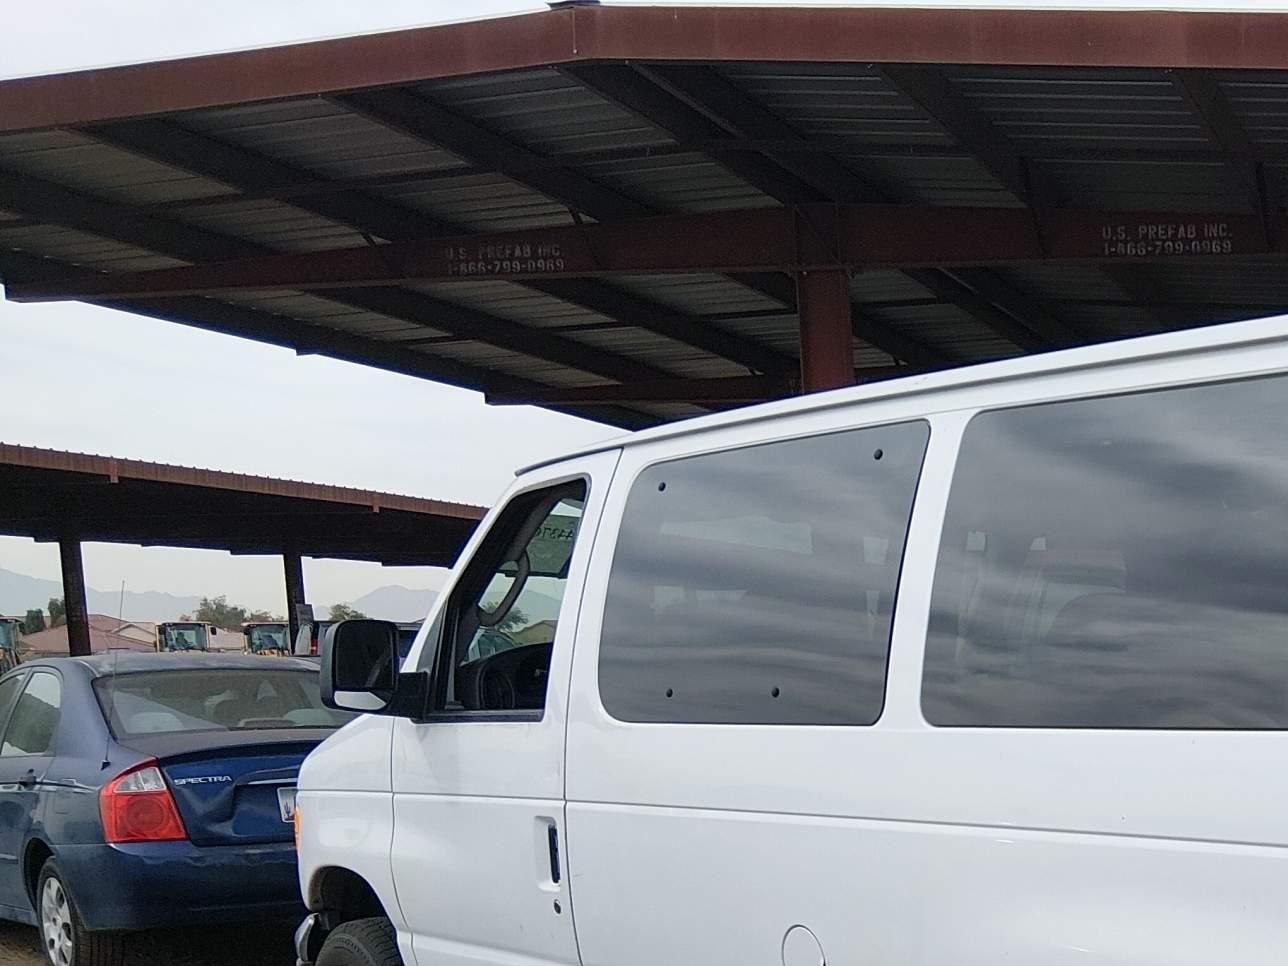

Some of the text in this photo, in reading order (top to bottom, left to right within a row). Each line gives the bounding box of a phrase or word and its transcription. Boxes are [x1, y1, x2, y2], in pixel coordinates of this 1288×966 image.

[1102, 223, 1233, 241] U.S. PREFAB INC.
[174, 775, 233, 786] SPECTRA
